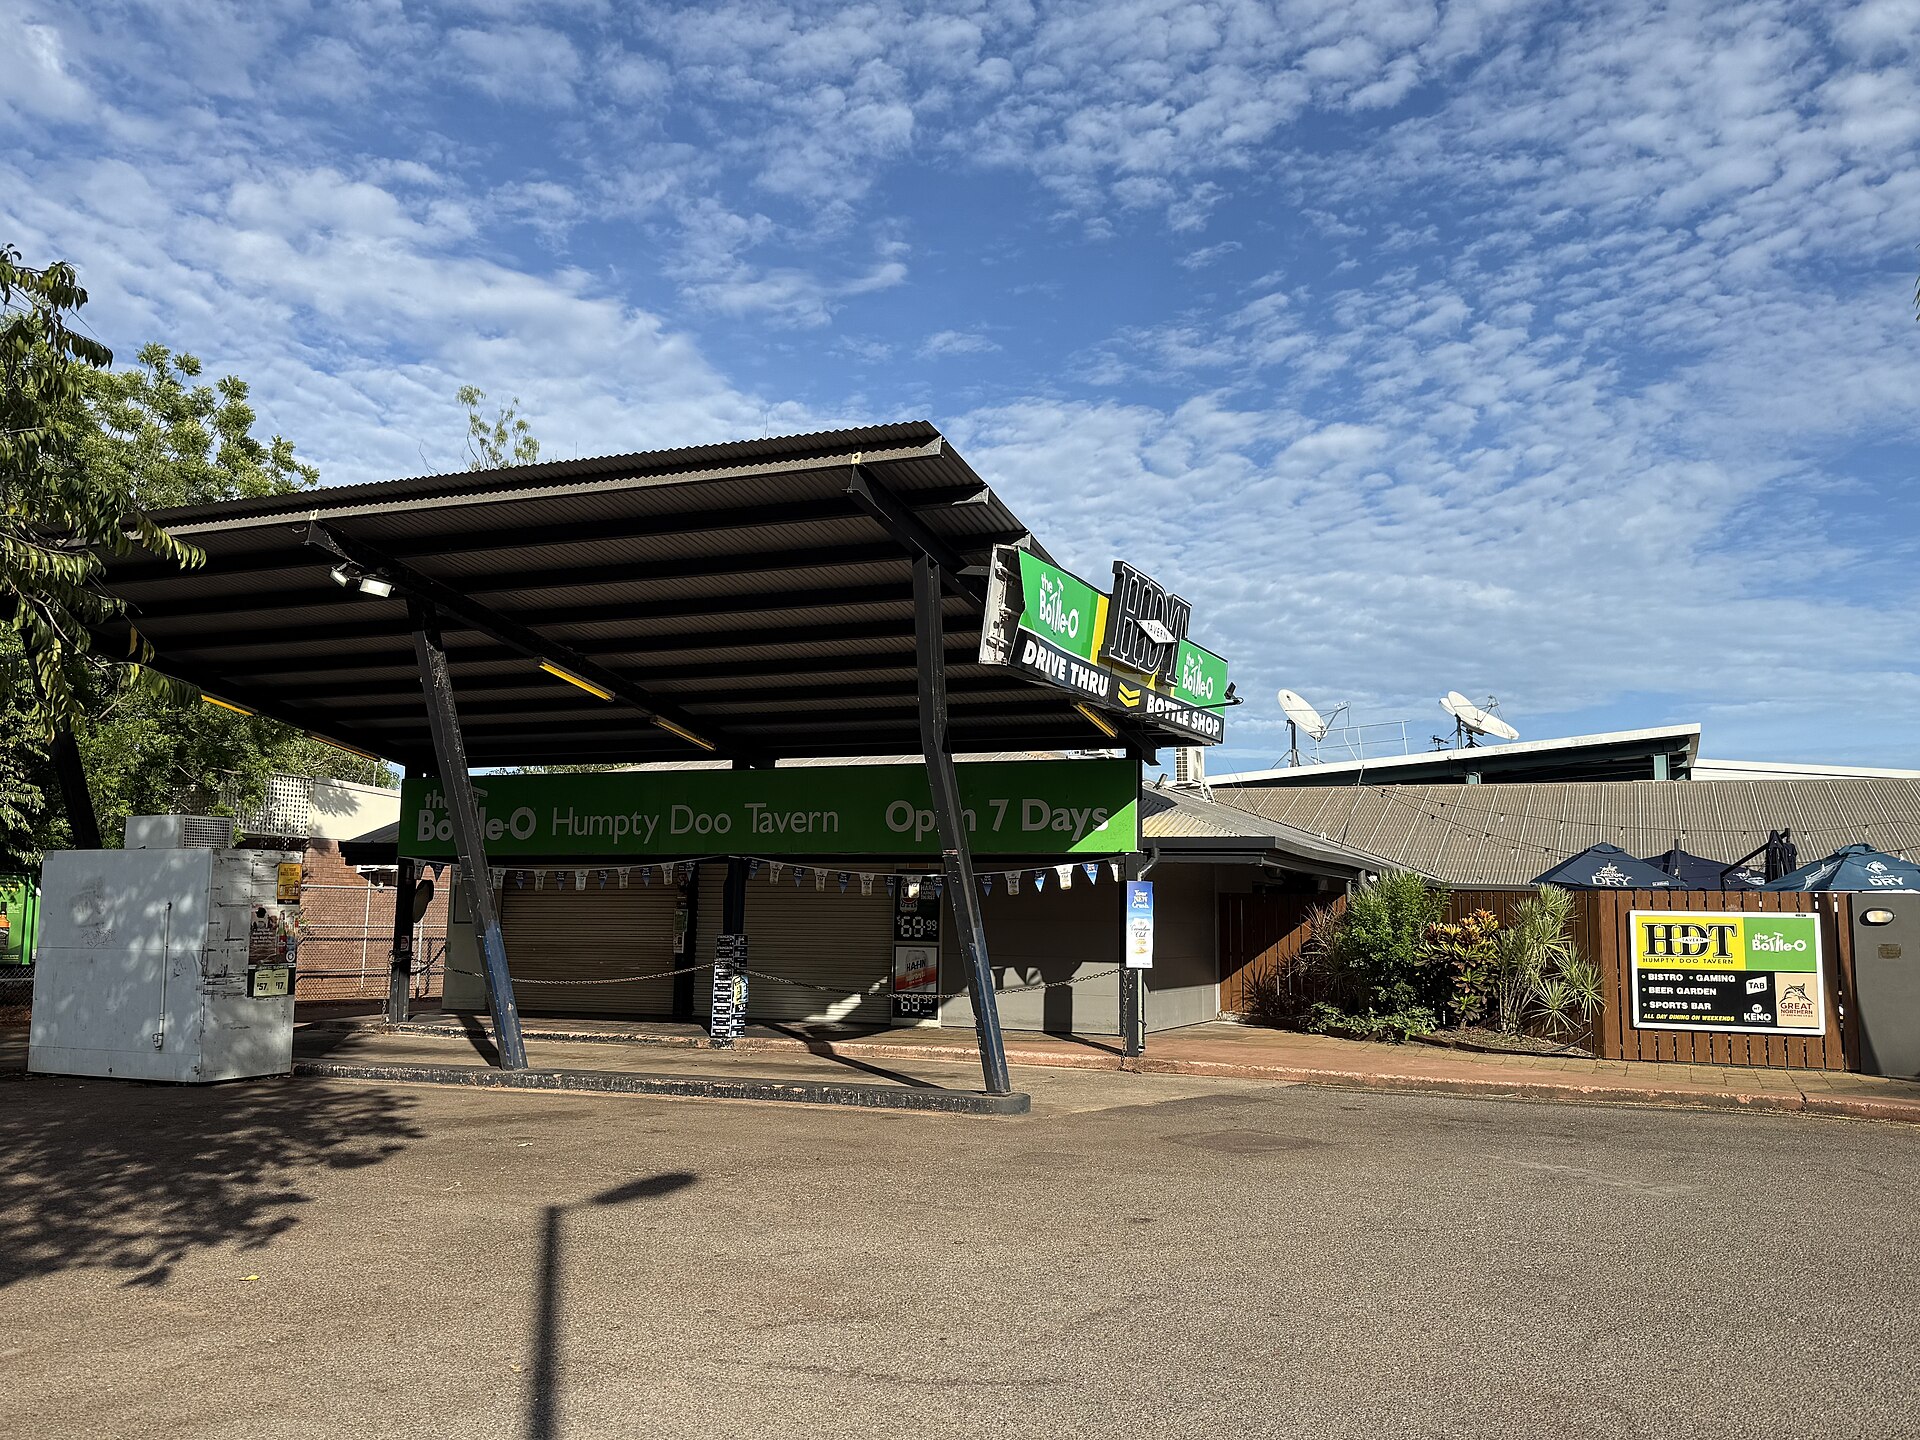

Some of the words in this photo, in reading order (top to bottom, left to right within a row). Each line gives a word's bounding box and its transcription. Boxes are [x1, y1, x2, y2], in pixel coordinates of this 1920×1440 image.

[1041, 572, 1053, 594] the
[1104, 560, 1193, 687] HDT
[1147, 622, 1169, 642] TAVERN
[1186, 651, 1195, 668] the
[1021, 639, 1067, 681] DRIVE
[1070, 662, 1109, 697] THRU
[1146, 693, 1190, 727] BOTTLE
[1191, 711, 1220, 737] SHOP
[417, 787, 537, 842] Bole-O
[552, 805, 659, 845] Humpty
[670, 804, 732, 835] Doo
[744, 802, 839, 834] Tavern
[885, 799, 976, 842] Opn
[989, 798, 1010, 832] 7
[1022, 798, 1109, 841] Days
[1591, 876, 1634, 887] DRY
[1867, 877, 1904, 886] DRY
[1642, 922, 1738, 958] HDT
[1754, 932, 1769, 941] the
[906, 959, 926, 971] HAHN
[1647, 973, 1684, 982] BISTRO
[1695, 974, 1736, 983] GAMING
[1648, 986, 1674, 995] BEER
[1676, 987, 1717, 996] GARDEN
[1749, 981, 1765, 990] TAB
[1649, 1001, 1689, 1009] SPORTS
[1690, 1002, 1712, 1011] BAR
[1780, 1002, 1813, 1010] GREAT
[1743, 1012, 1772, 1021] KENO
